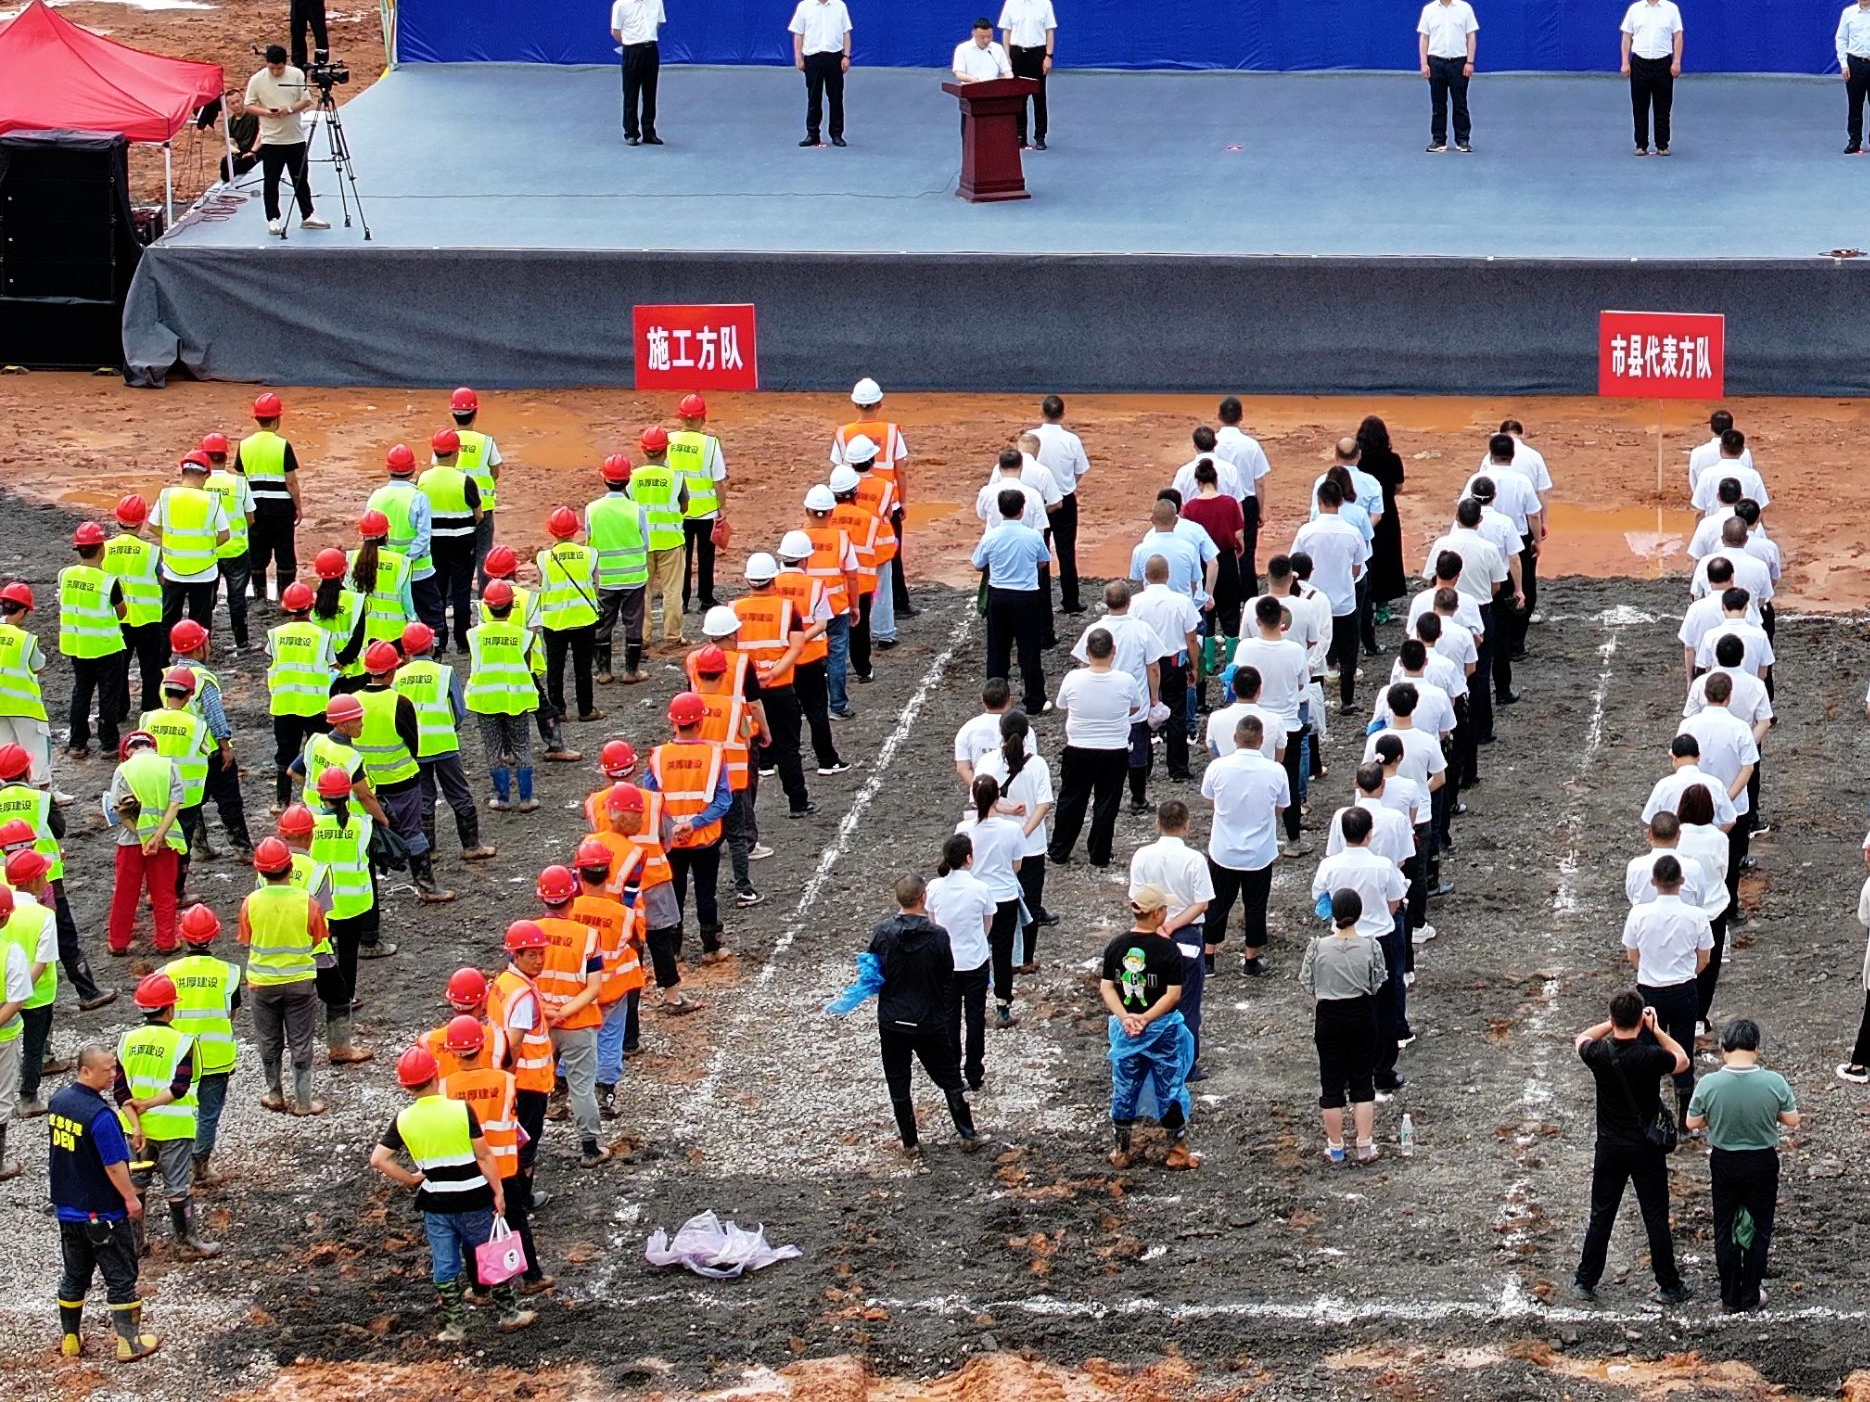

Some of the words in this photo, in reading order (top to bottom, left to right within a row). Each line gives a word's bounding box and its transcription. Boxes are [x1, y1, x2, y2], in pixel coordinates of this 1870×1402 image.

[646, 324, 744, 371] 施工方队
[1610, 333, 1712, 379] 市县代表方队
